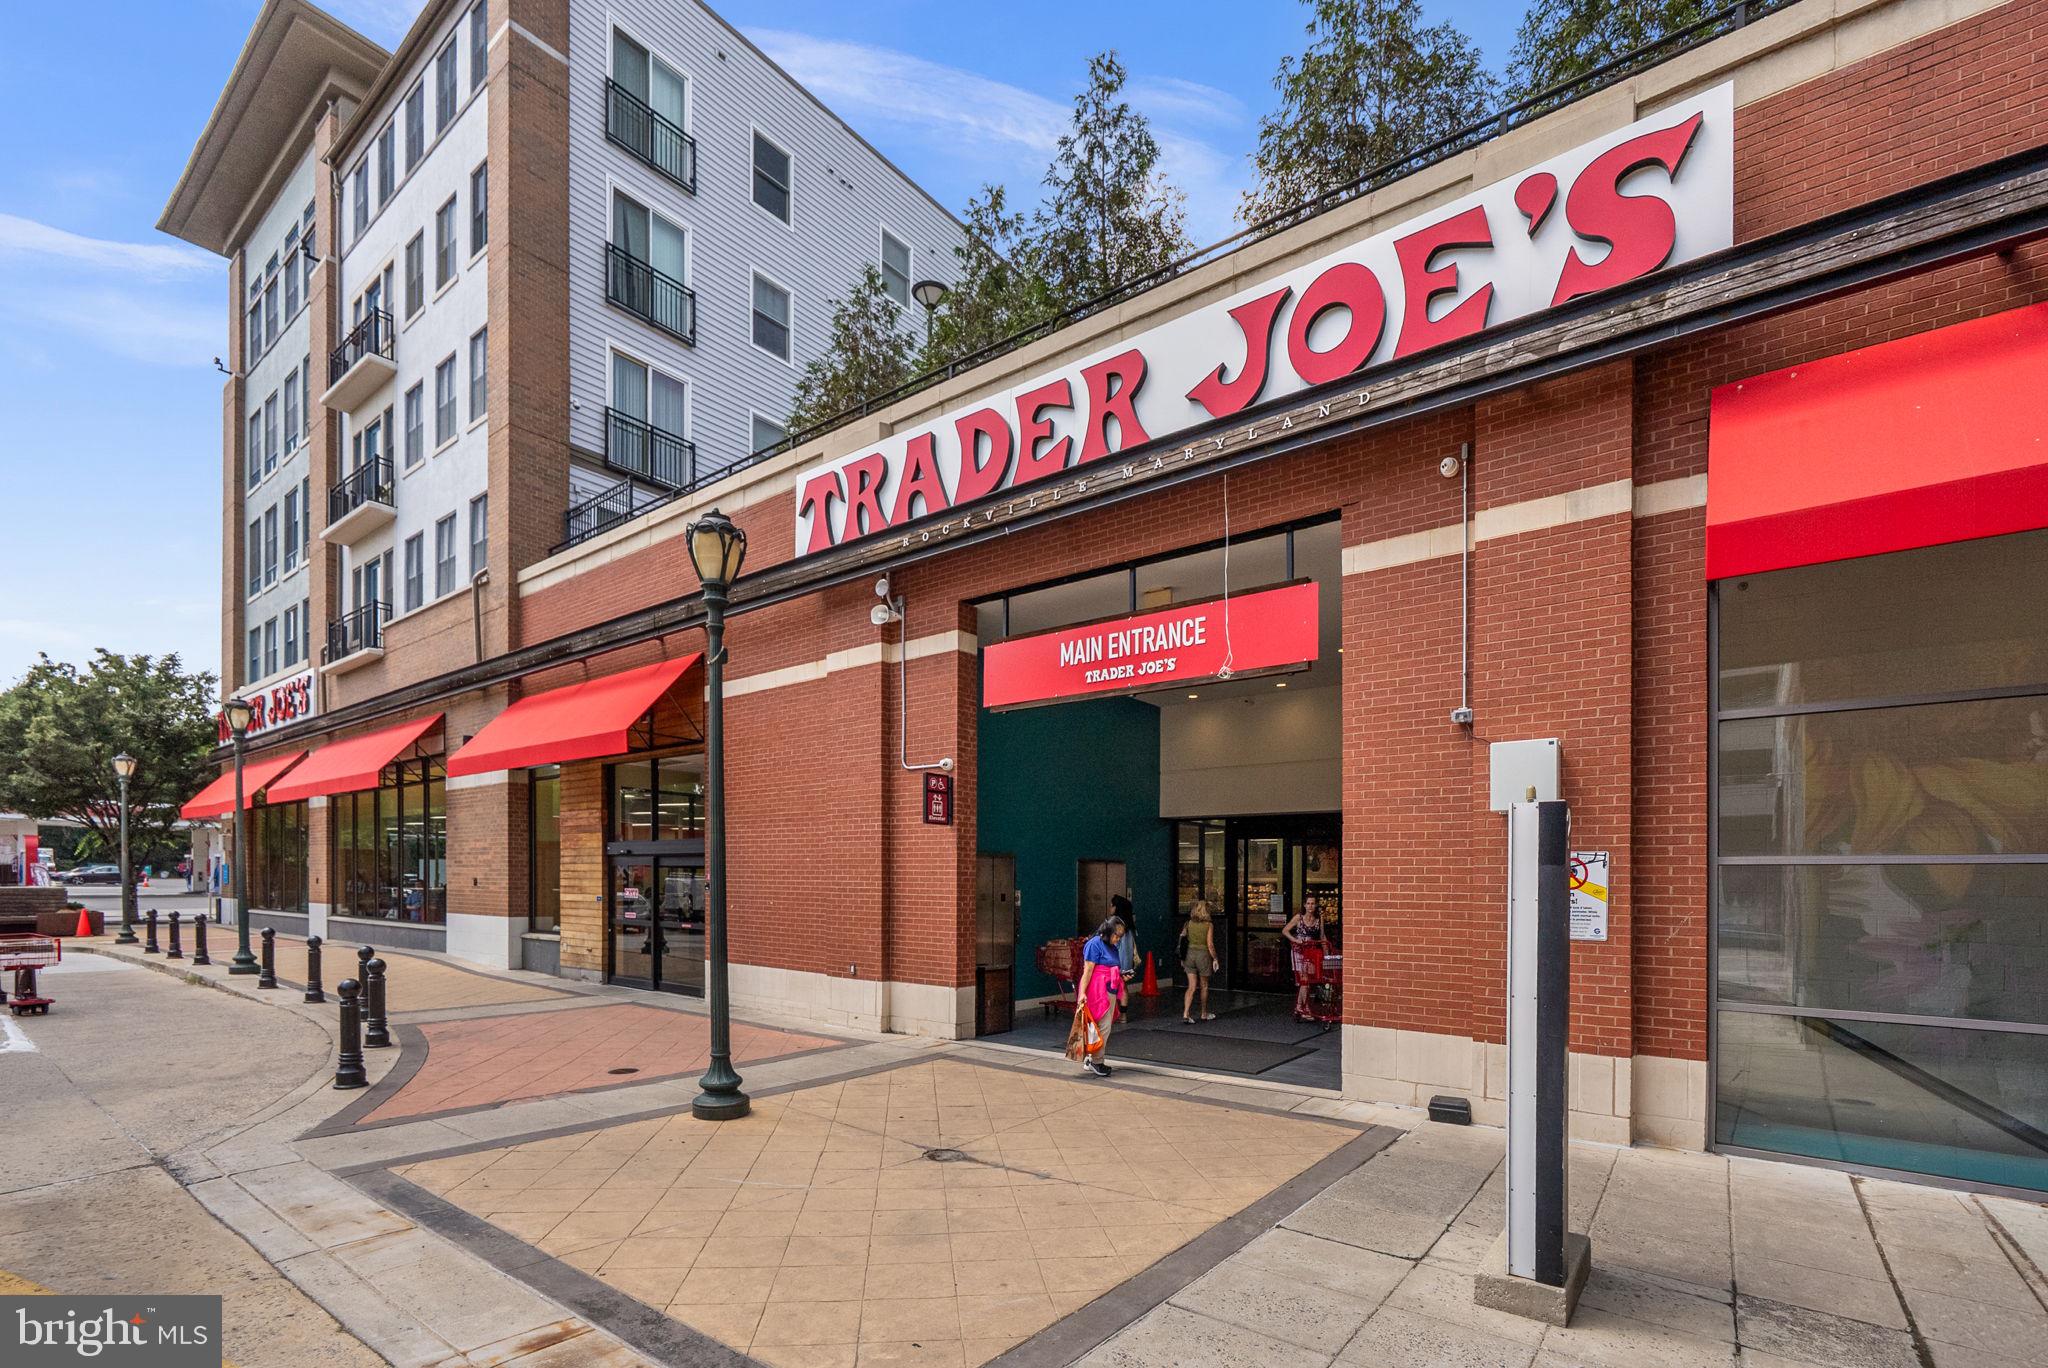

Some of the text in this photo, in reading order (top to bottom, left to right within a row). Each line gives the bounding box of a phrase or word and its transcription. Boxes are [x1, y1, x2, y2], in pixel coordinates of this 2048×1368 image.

[799, 110, 1704, 556] TRADER JOE'S
[902, 391, 1371, 547] ROCKVILLE MARYLAND
[1060, 616, 1207, 667] MAIN ENTRANCE
[1085, 658, 1177, 683] TRADER JOE'S
